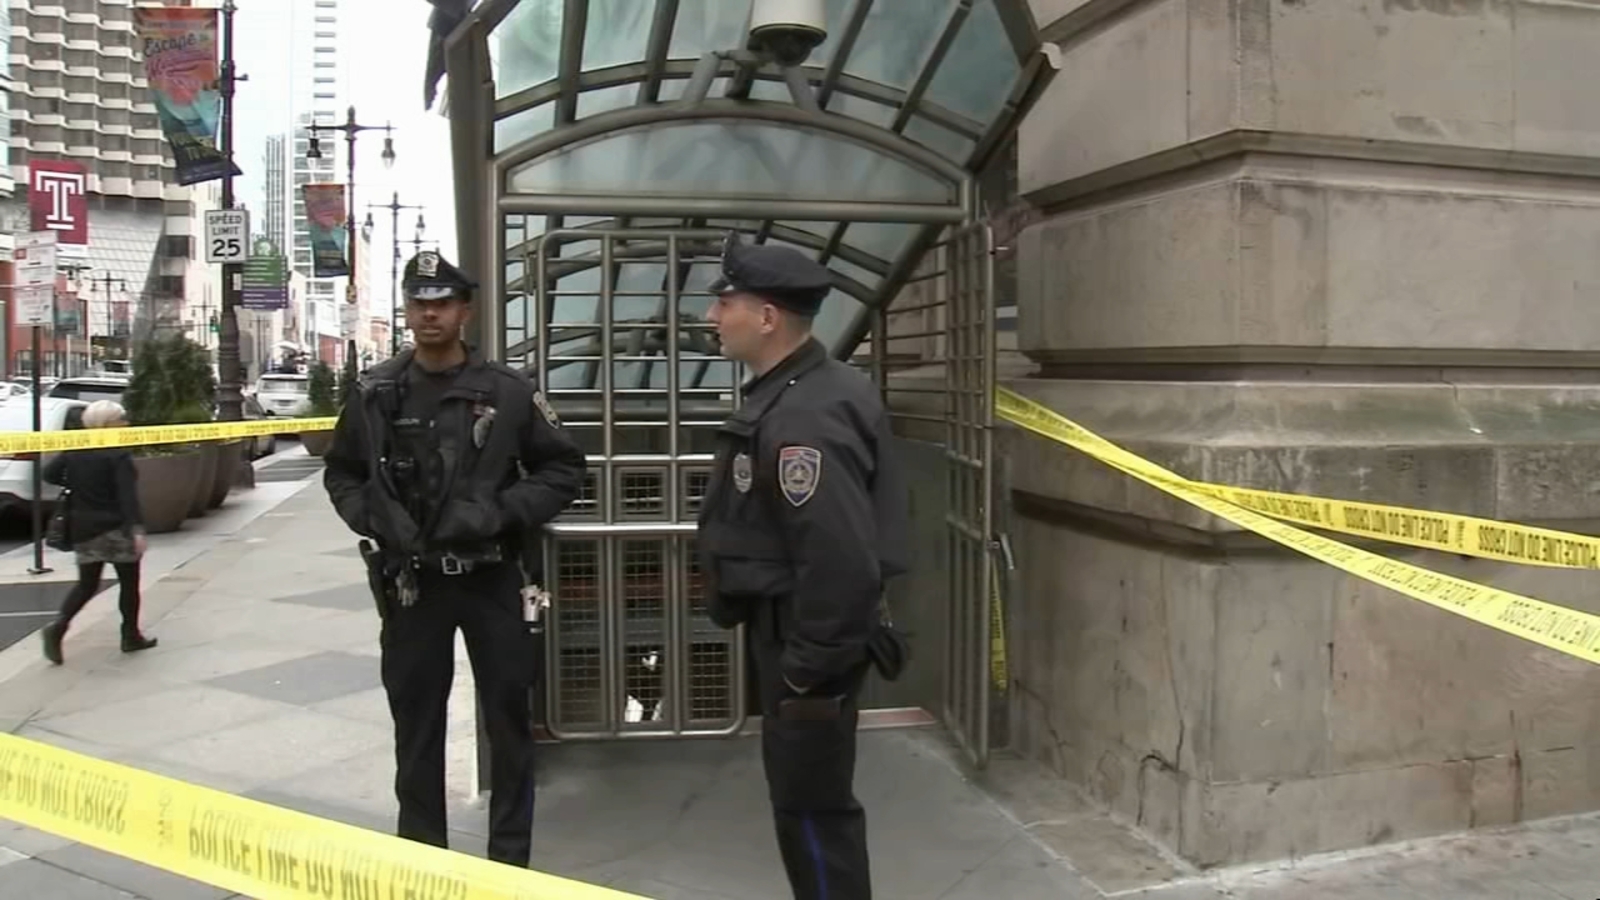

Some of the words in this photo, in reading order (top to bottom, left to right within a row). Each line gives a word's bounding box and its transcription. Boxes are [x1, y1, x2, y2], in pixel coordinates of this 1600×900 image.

[144, 33, 196, 57] Escape
[35, 170, 84, 230] T
[209, 215, 242, 225] SPEED
[212, 226, 239, 236] LIMIT
[212, 238, 241, 257] 25
